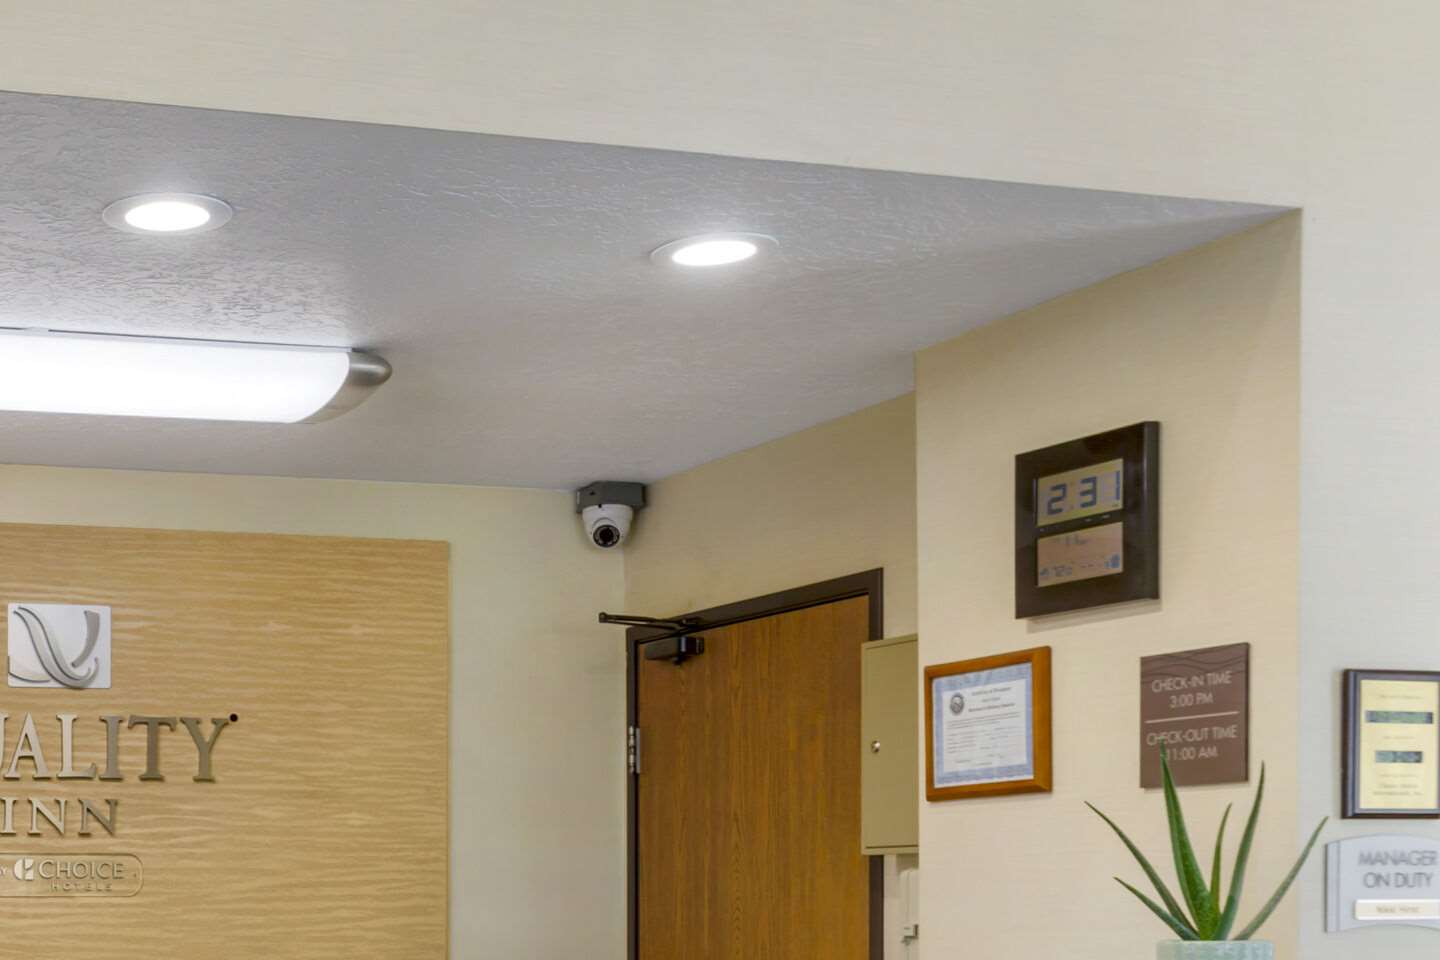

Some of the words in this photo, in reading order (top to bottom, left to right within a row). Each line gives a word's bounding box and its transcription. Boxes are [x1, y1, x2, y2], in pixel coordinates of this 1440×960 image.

[1151, 675, 1205, 693] CHECK-IN
[1206, 670, 1233, 686] TIME
[1169, 693, 1194, 708] 3:00
[1196, 692, 1214, 705] PM
[1146, 727, 1209, 746] CHECK-OUT
[1211, 724, 1239, 739] TIME
[1198, 745, 1219, 759] AM
[1358, 849, 1438, 867] MANAGER
[38, 858, 125, 880] CHOICE
[1362, 871, 1391, 889] ON
[1393, 871, 1433, 889] DUTY
